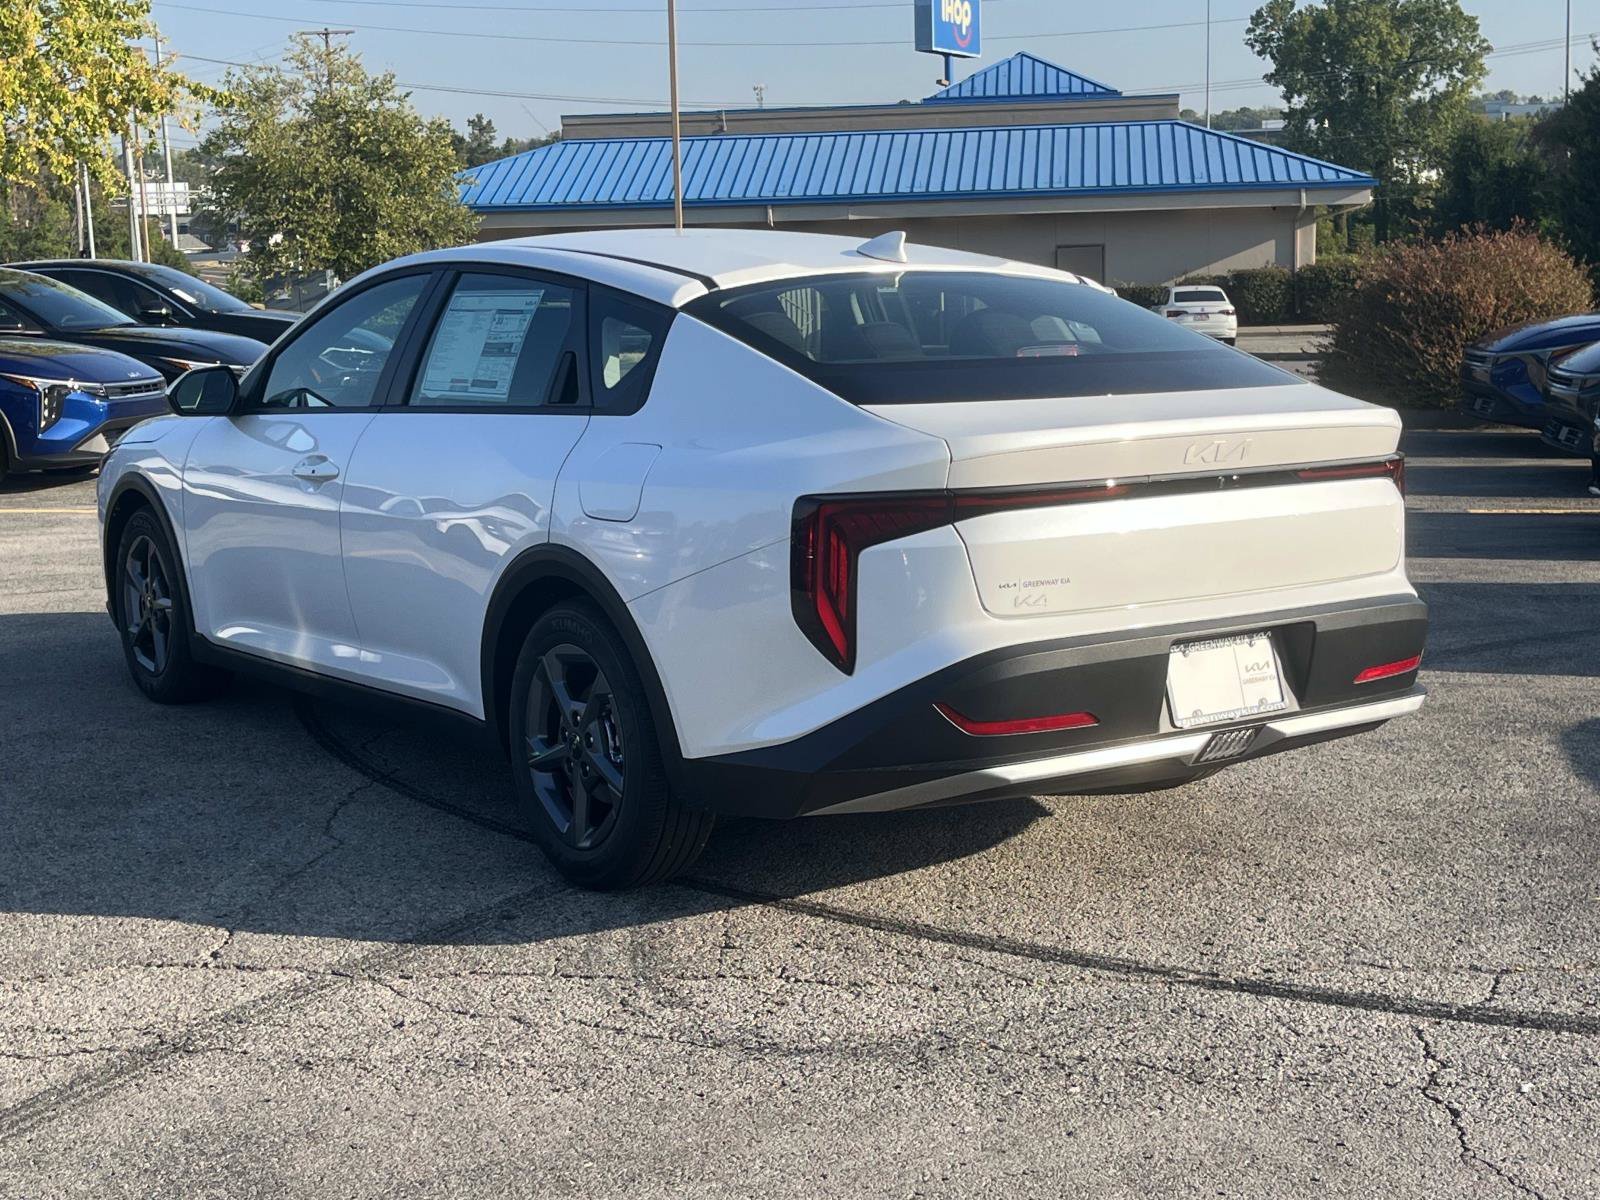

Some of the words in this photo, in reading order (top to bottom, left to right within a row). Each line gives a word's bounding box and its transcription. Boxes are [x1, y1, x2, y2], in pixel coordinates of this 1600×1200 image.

[1183, 439, 1252, 465] KIA
[1023, 579, 1059, 588] GREENWAY
[1014, 594, 1047, 608] K4
[1188, 637, 1234, 652] GREENWAY
[1244, 661, 1270, 673] KIA
